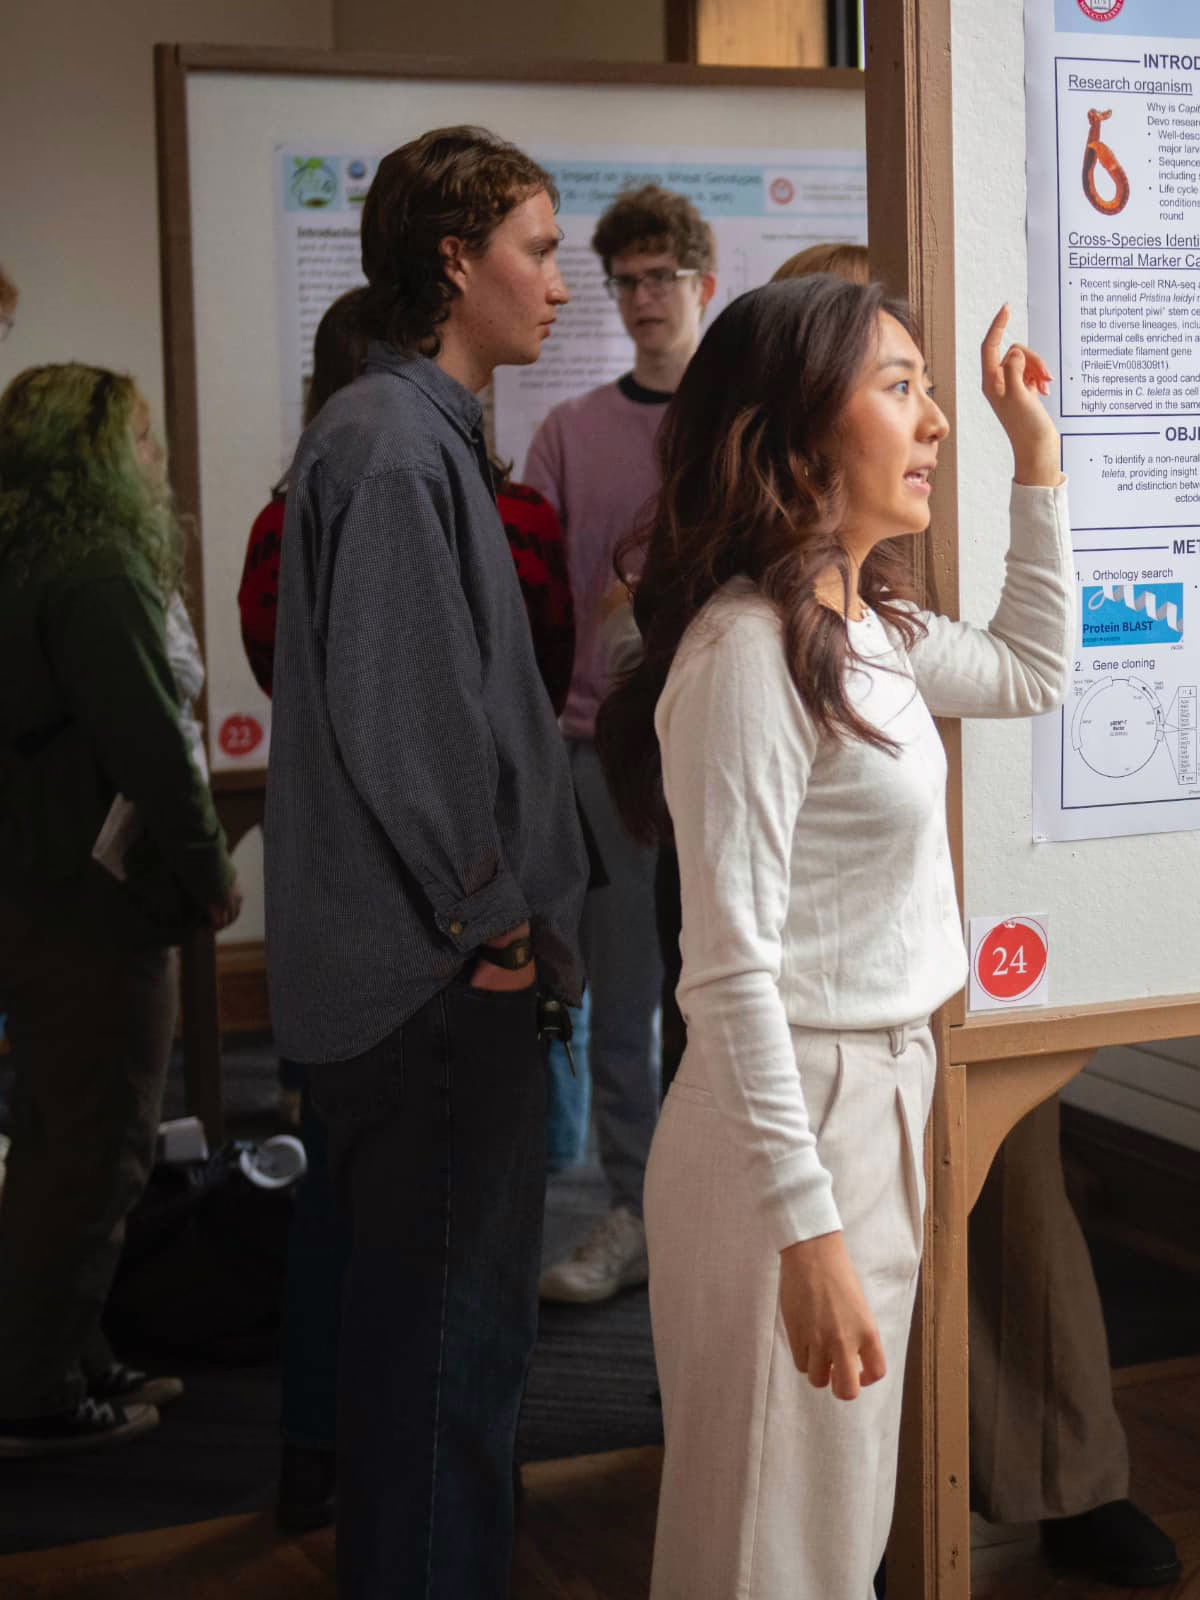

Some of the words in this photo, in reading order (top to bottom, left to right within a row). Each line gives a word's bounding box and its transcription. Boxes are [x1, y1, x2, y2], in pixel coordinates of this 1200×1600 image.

[1067, 74, 1131, 92] Research
[1133, 78, 1193, 94] organism
[1146, 102, 1166, 114] Why
[1146, 115, 1170, 126] Devo
[1157, 143, 1182, 155] major
[1157, 170, 1197, 183] including
[1158, 183, 1175, 194] Life
[1176, 184, 1199, 196] cycle
[1158, 210, 1184, 221] round
[1067, 232, 1162, 250] Cross-Species
[1068, 252, 1134, 269] Epidermal
[1136, 253, 1181, 270] Marker
[1079, 346, 1134, 356] intermediate
[1134, 345, 1170, 356] filament
[1170, 348, 1192, 358] gene
[1081, 373, 1100, 383] This
[1101, 374, 1147, 385] represents
[1155, 373, 1178, 385] good
[1116, 482, 1134, 491] and
[1134, 480, 1178, 491] distinction
[1091, 568, 1139, 583] Orthology
[1140, 567, 1174, 579] search
[1081, 621, 1120, 634] Protein
[1121, 620, 1153, 632] BLAST
[1092, 659, 1119, 670] Gene
[1120, 657, 1156, 671] cloning
[992, 945, 1028, 976] 24
